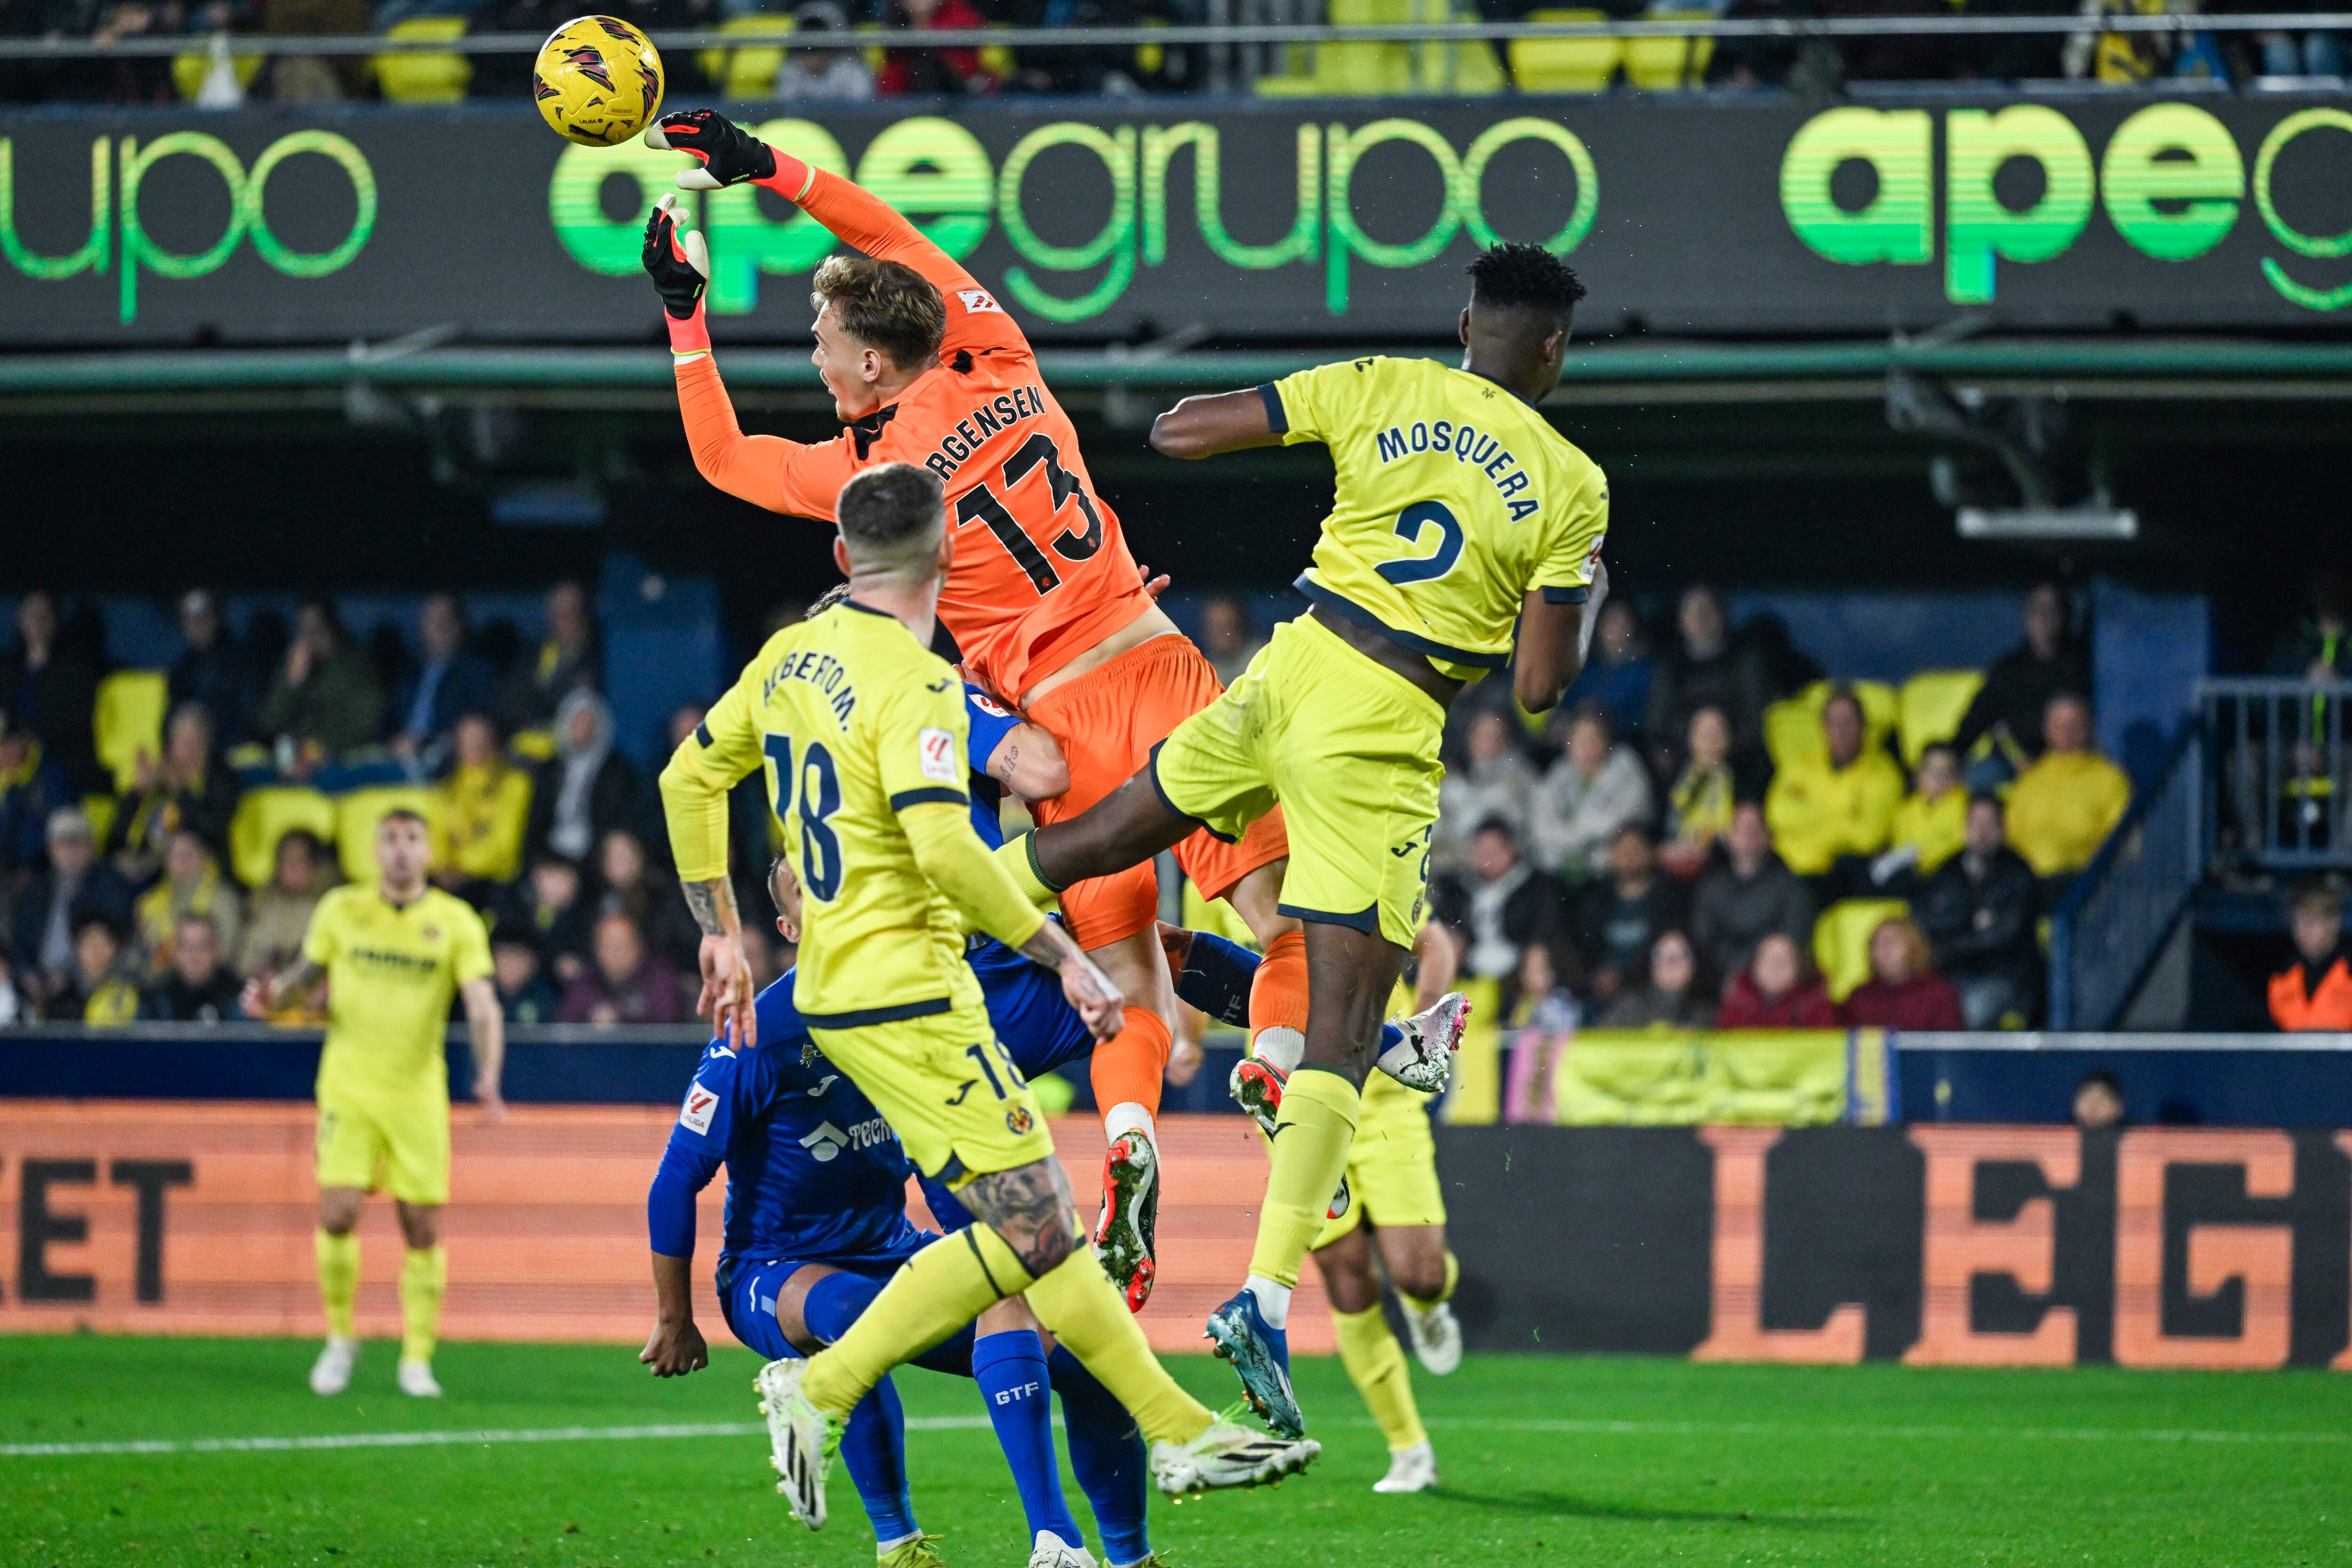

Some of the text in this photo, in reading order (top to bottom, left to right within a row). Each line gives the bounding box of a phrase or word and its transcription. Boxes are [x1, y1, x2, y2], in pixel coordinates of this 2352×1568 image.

[549, 116, 1600, 323] apegrupo
[923, 385, 1046, 489] RGENSEN
[1376, 420, 1540, 524] MOSQUERA
[954, 431, 1103, 597] 13
[1373, 499, 1465, 586] 2
[683, 1113, 705, 1129] LALIGA
[0, 1158, 194, 1304] ET
[1691, 1122, 2352, 1368] LEG
[995, 1382, 1039, 1405] GTF
